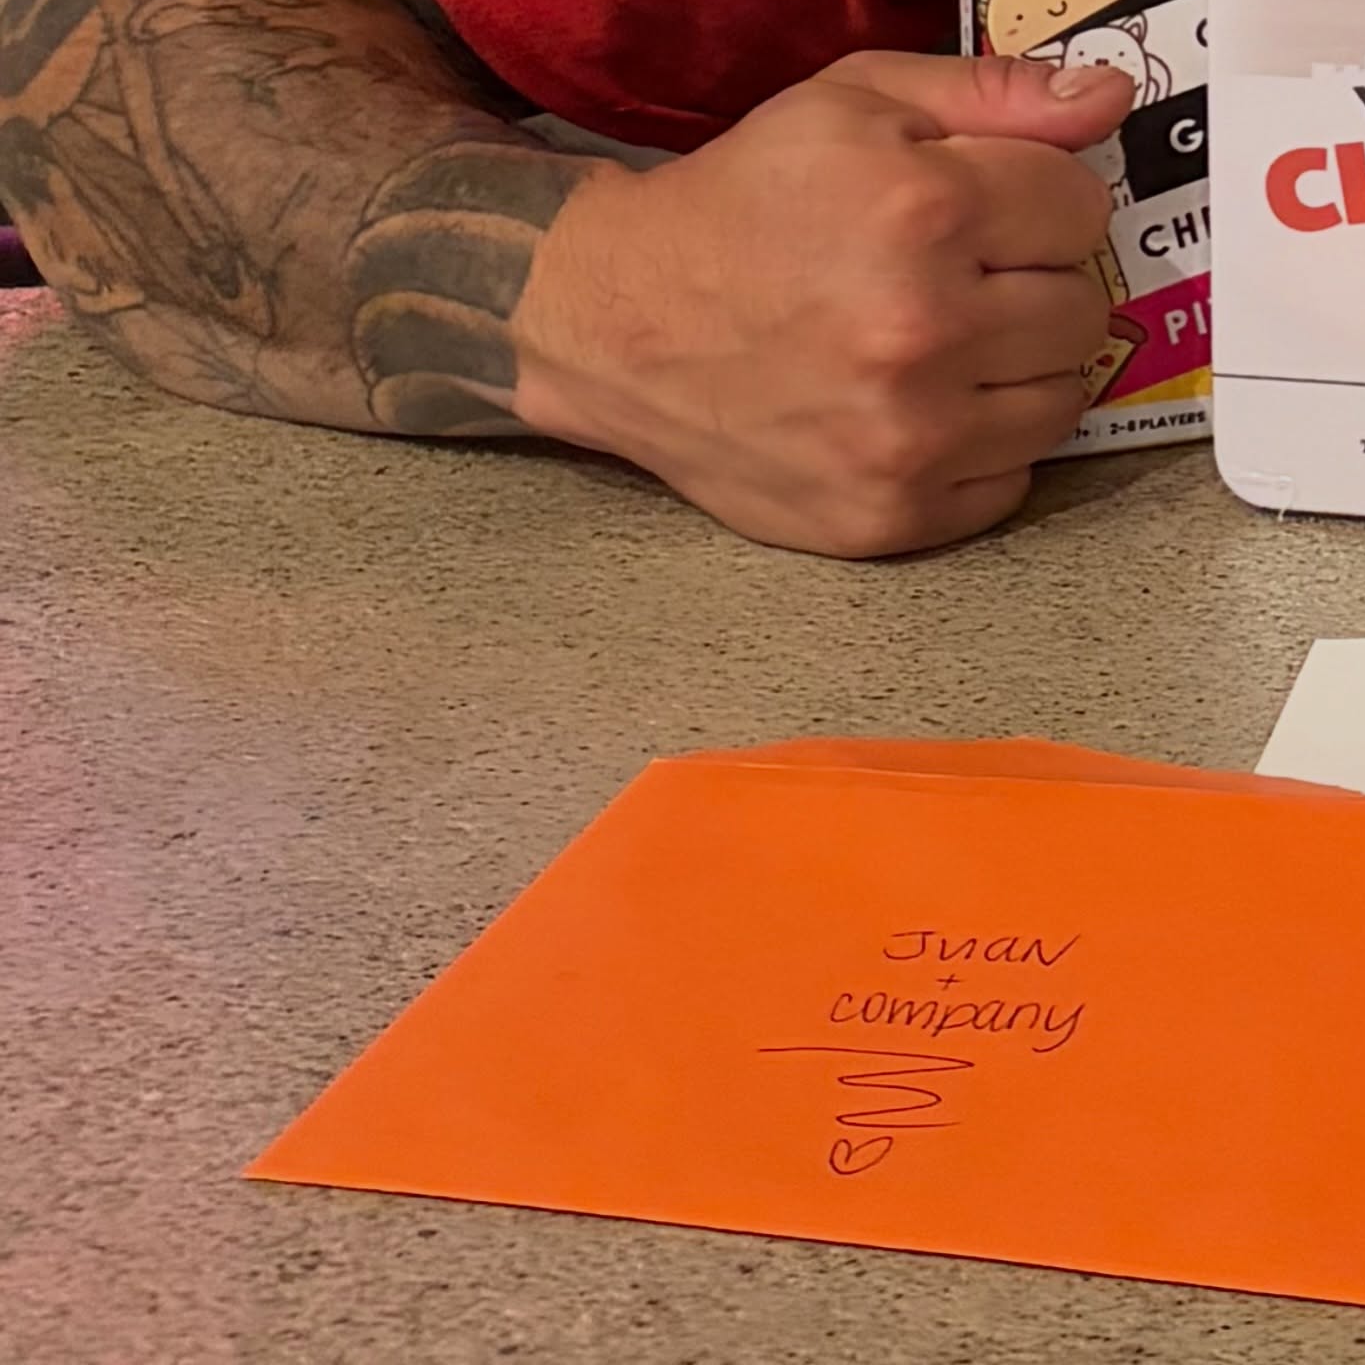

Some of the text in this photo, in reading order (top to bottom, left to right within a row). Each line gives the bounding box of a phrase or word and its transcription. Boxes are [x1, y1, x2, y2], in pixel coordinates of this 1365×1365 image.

[1139, 411, 1206, 430] PLAYERS
[883, 930, 1081, 966] Juan
[829, 991, 1086, 1053] company
